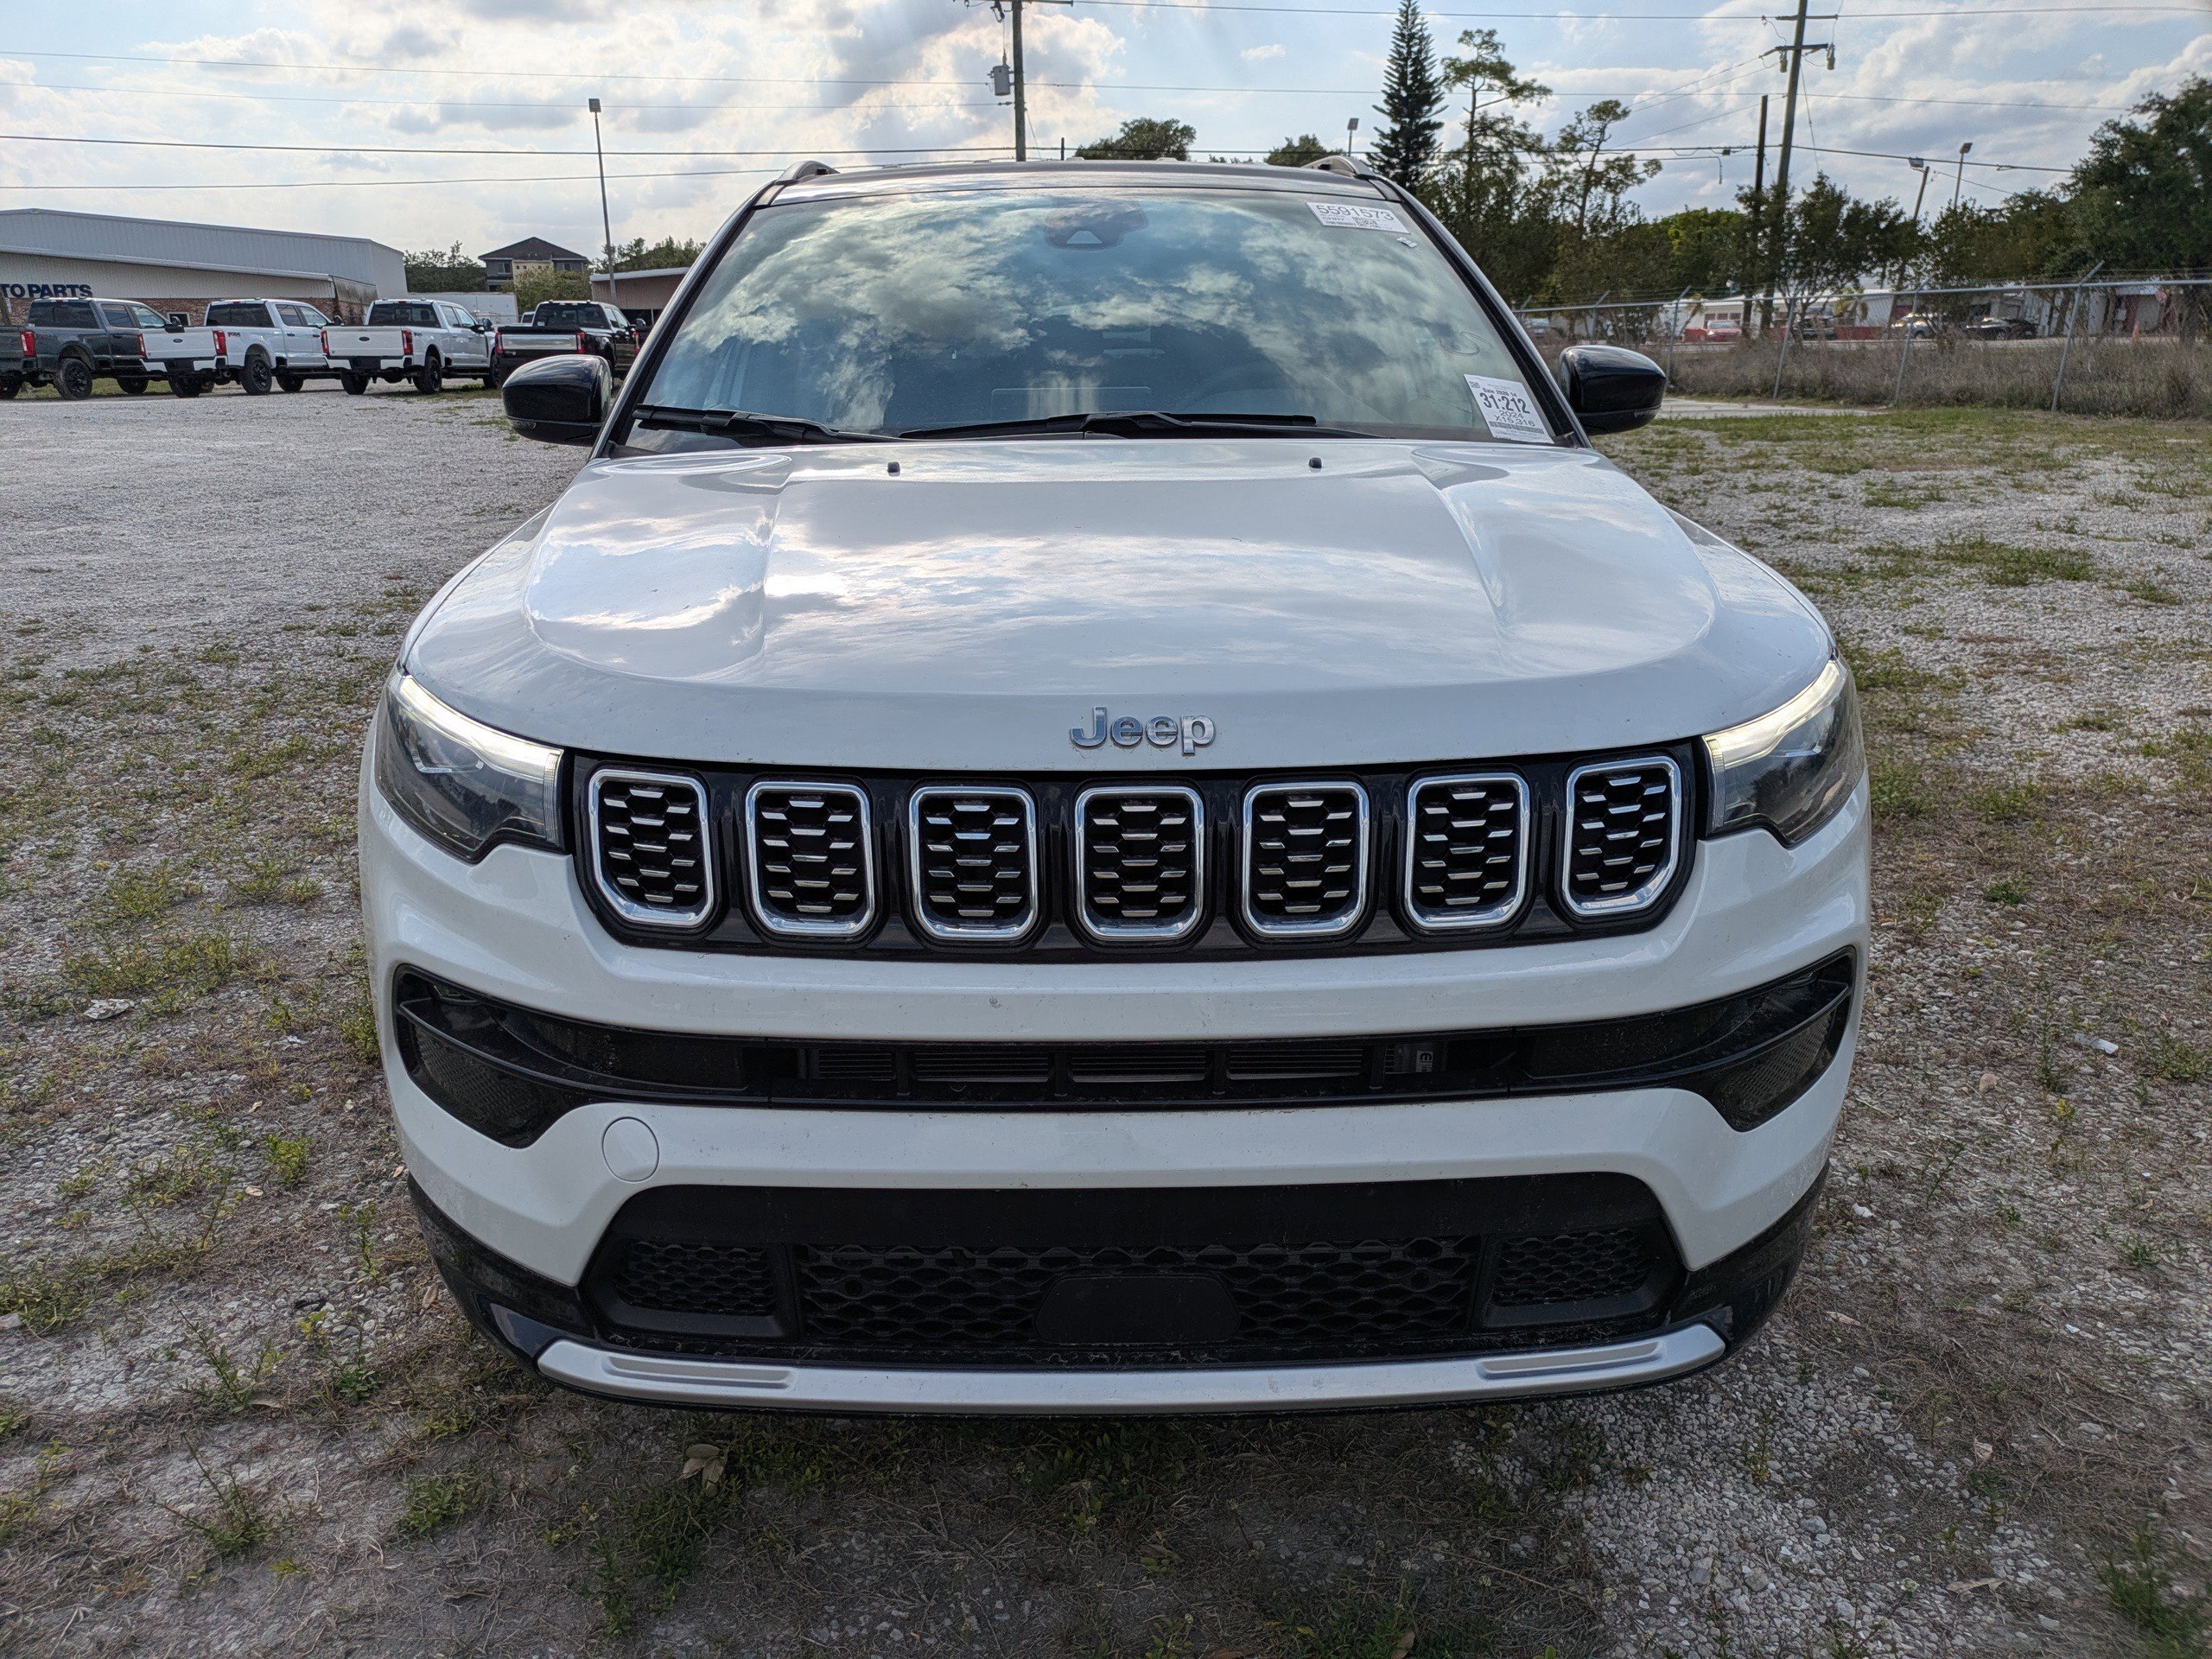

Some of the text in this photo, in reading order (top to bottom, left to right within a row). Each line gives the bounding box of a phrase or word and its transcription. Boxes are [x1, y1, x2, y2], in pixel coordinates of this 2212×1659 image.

[1316, 205, 1395, 221] 5591573
[27, 283, 93, 298] PARTS
[1479, 392, 1531, 415] 31:212
[1498, 410, 1524, 419] 2024
[1071, 705, 1216, 756] Jeep
